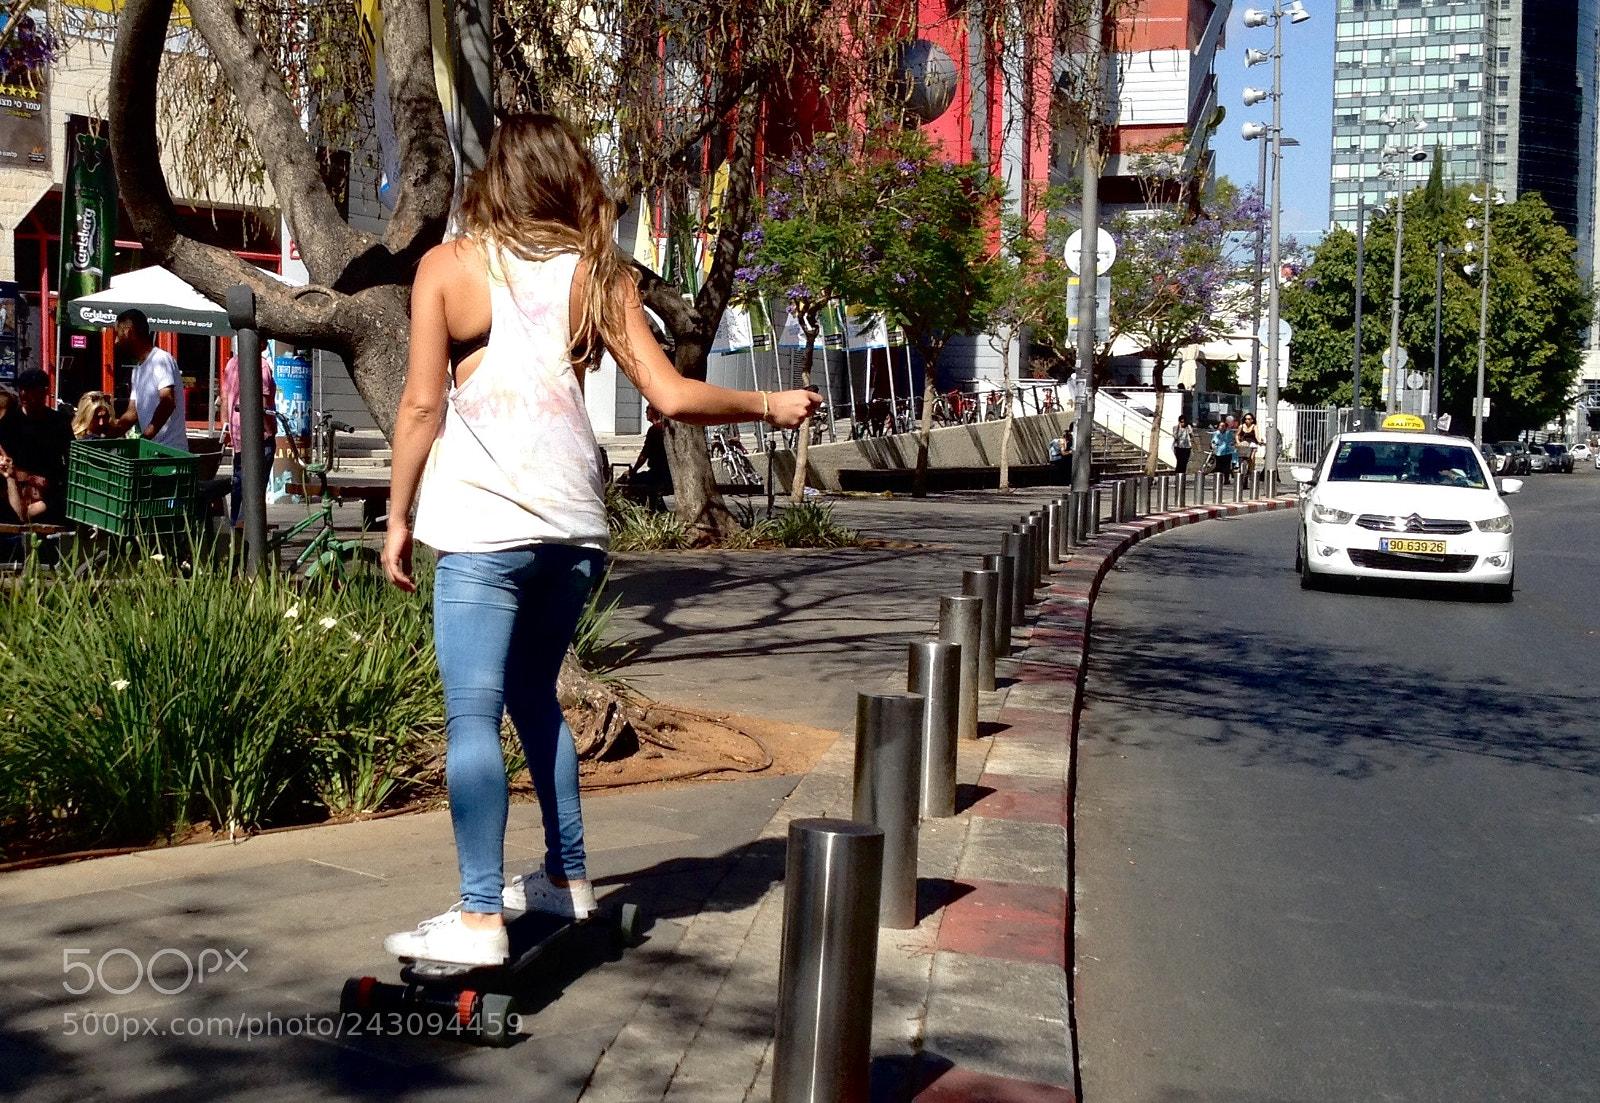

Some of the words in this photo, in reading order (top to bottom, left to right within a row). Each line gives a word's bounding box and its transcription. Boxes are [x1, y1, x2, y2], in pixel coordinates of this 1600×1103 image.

[74, 207, 96, 268] Carlsberg
[80, 306, 117, 323] Carlsberg
[169, 318, 181, 326] beer
[1390, 540, 1404, 551] 90
[1407, 541, 1428, 552] 639
[1430, 542, 1444, 553] 26
